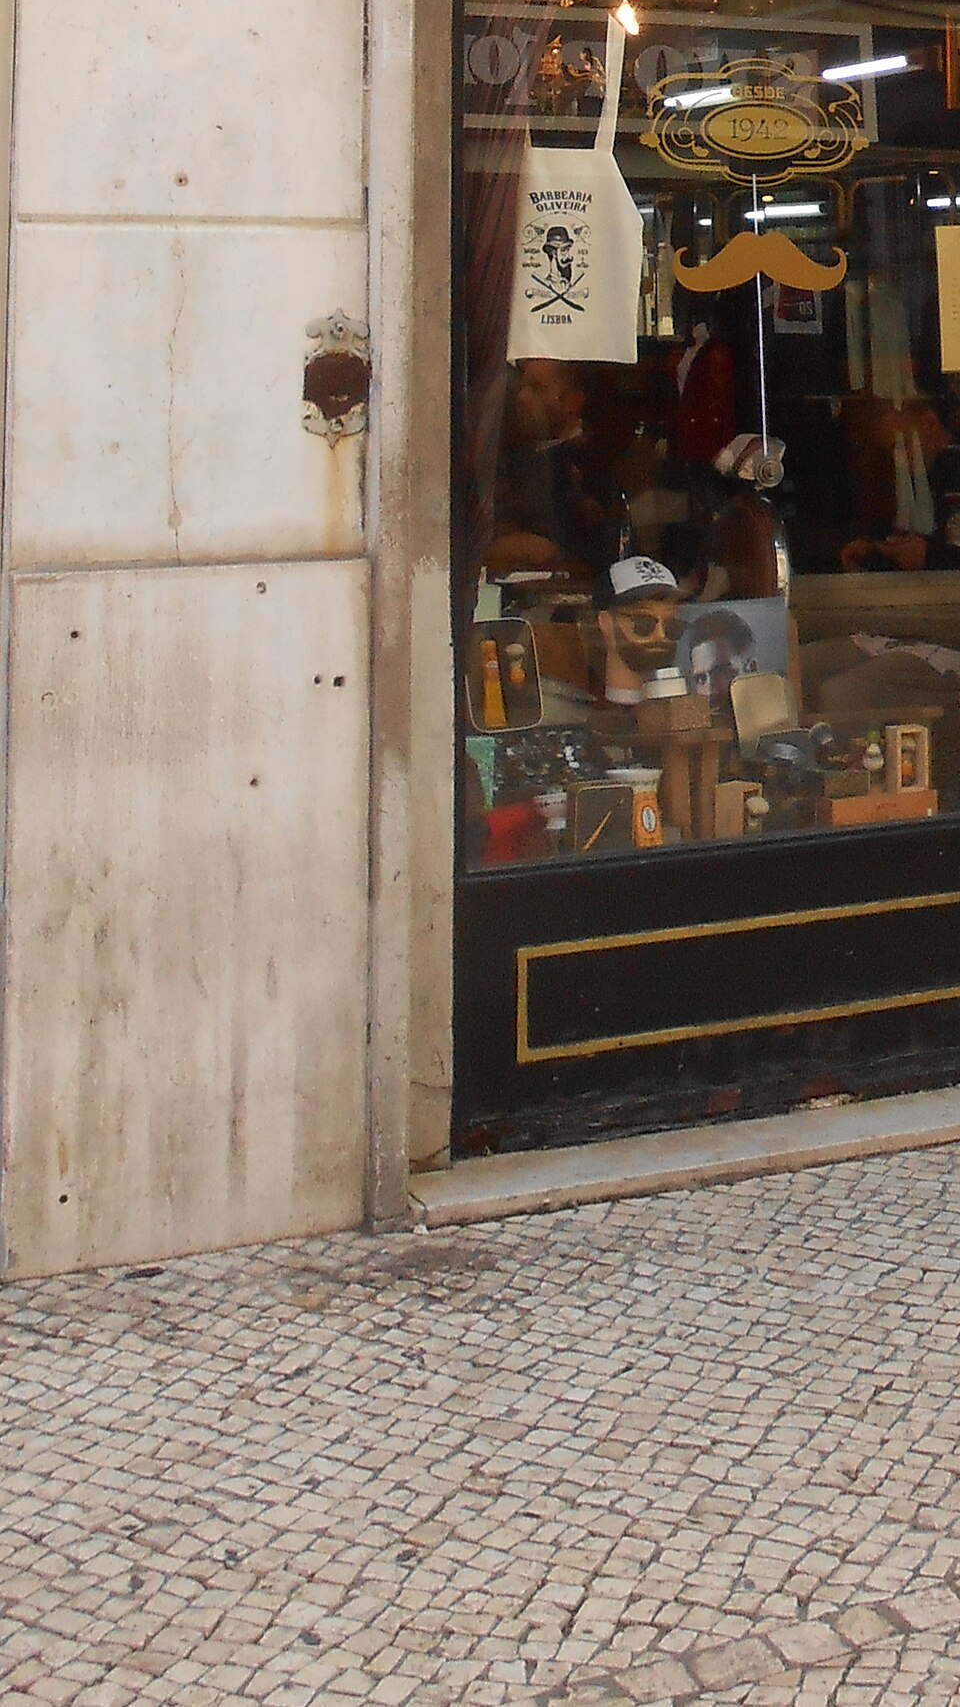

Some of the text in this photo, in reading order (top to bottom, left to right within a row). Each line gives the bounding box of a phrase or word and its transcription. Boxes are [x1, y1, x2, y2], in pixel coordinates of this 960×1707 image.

[728, 117, 790, 143] 1942
[529, 190, 593, 205] BARBEARIA
[536, 201, 588, 214] OLIVEIRA
[540, 314, 573, 325] LISBOA
